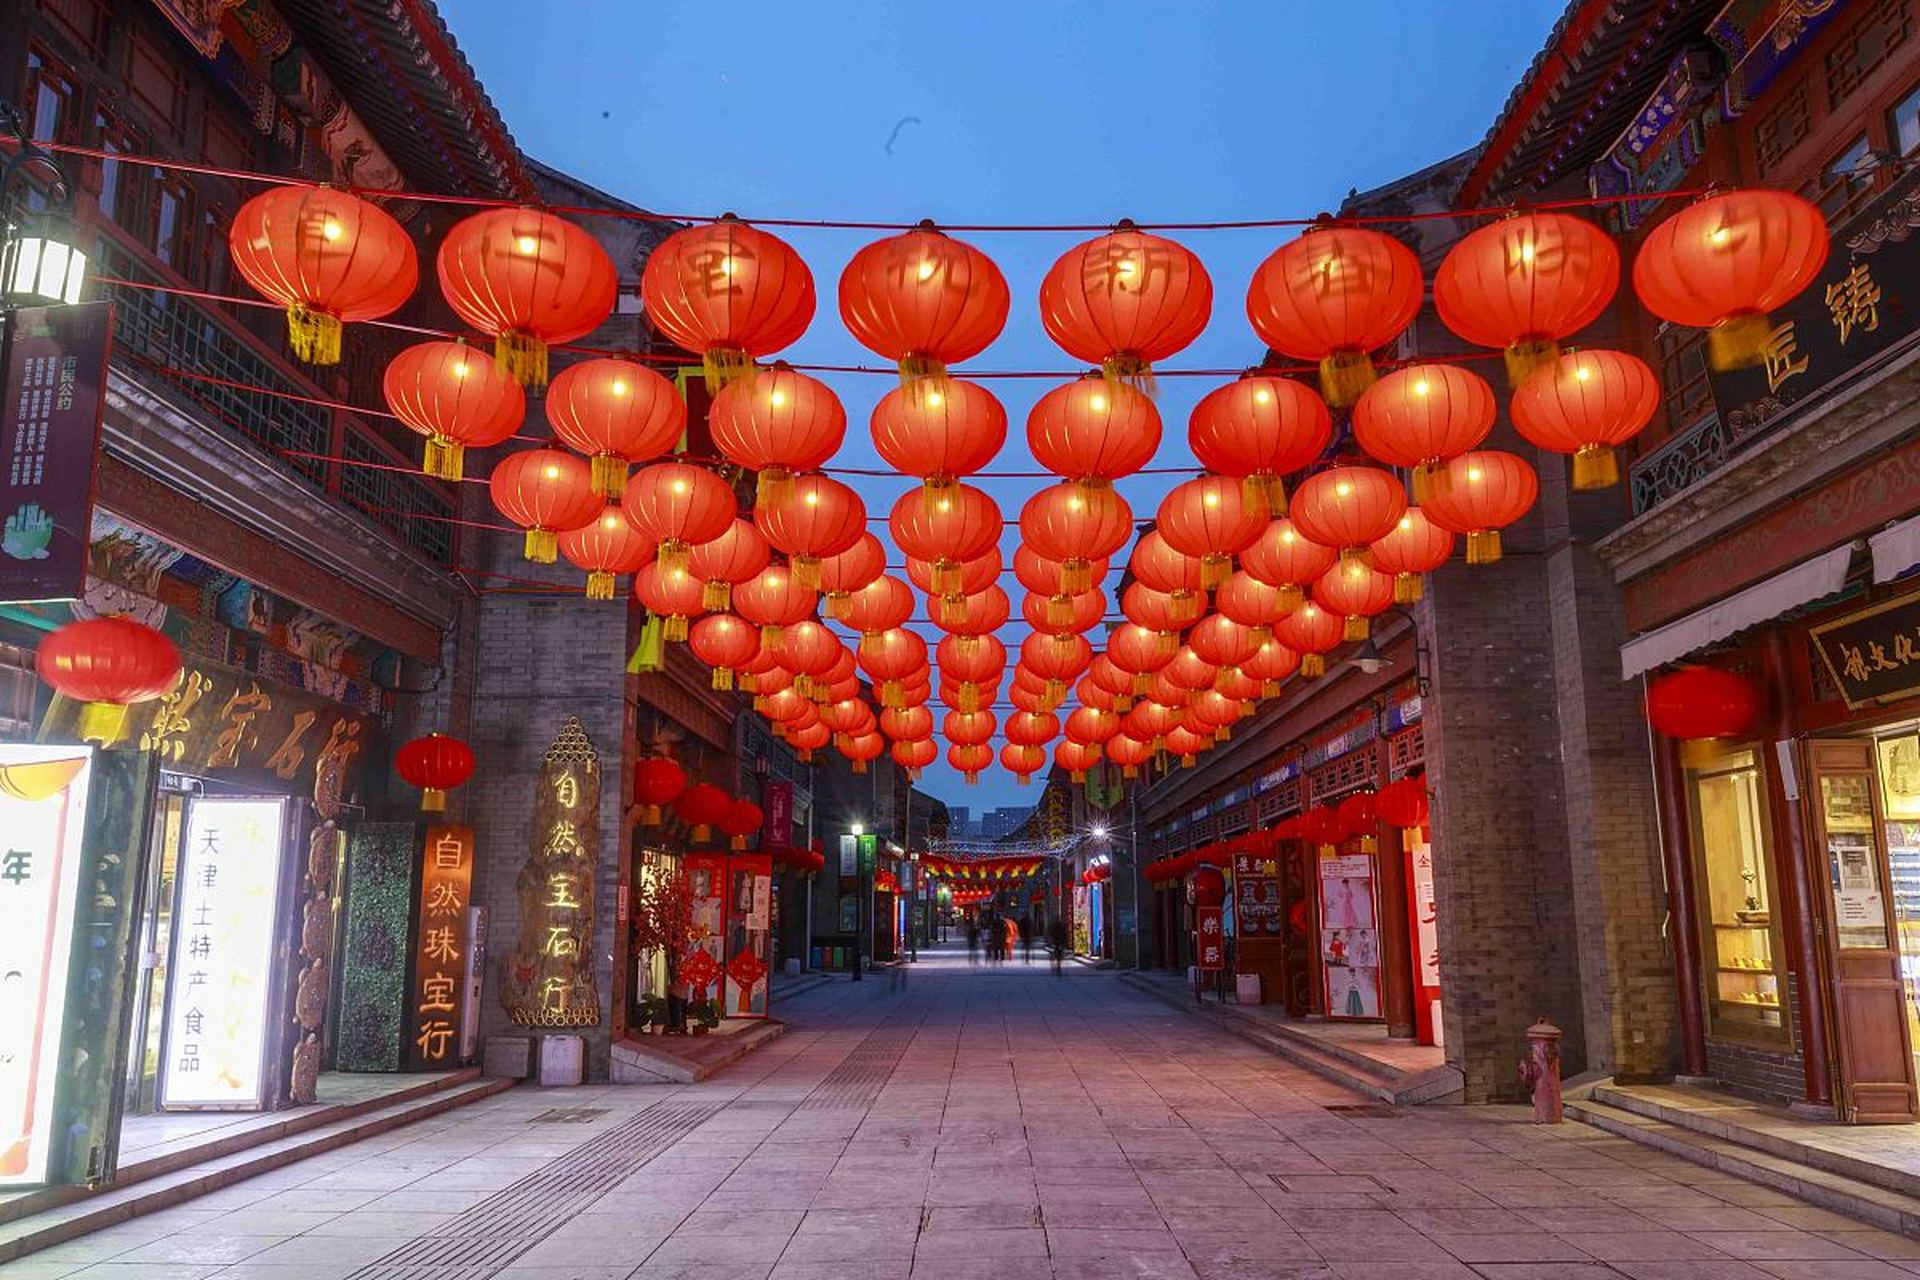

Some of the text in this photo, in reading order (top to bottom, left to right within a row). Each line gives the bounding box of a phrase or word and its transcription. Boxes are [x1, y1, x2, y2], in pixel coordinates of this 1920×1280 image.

[56, 355, 78, 411] 市民公约
[83, 667, 361, 779] 然宝石行
[178, 828, 220, 1073] 天津土特产食品
[416, 833, 463, 1060] 自然珠宝行
[541, 769, 584, 1014] 自然宝石行
